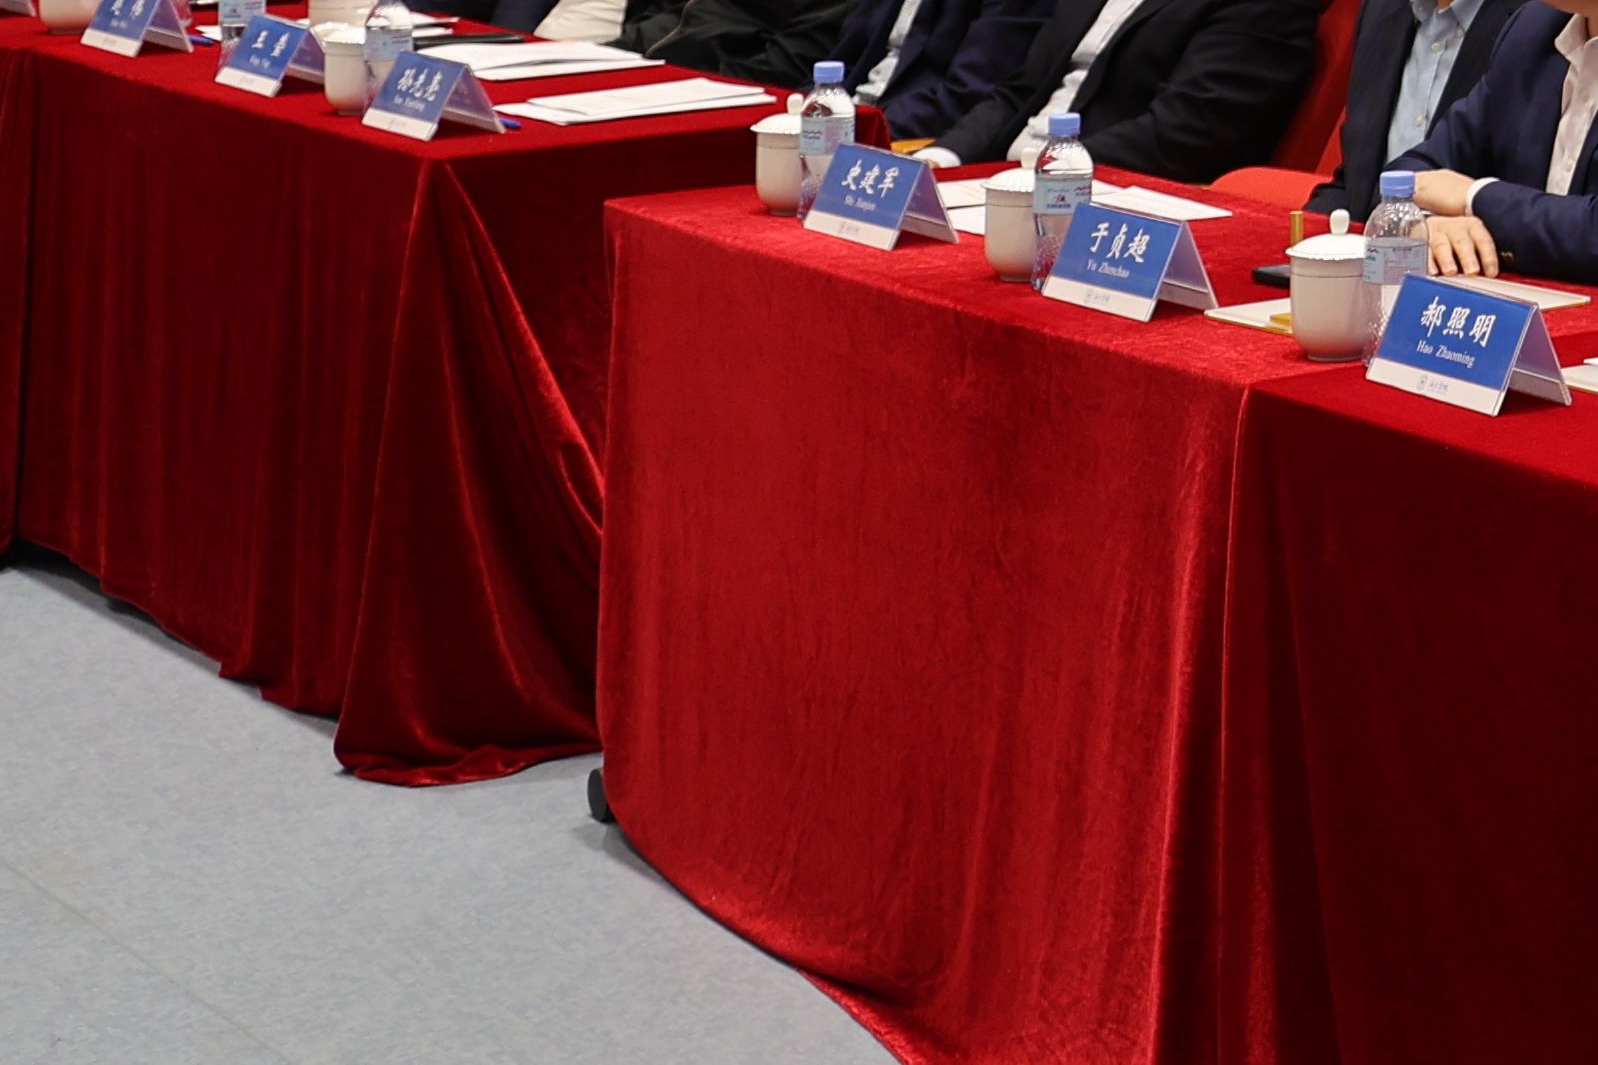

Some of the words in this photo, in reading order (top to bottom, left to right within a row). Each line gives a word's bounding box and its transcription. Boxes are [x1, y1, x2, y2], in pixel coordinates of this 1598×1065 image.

[841, 159, 900, 198] 史建军
[1090, 222, 1150, 263] 于贞超
[1086, 259, 1096, 271] Yu
[1420, 296, 1496, 348] 郝照明
[1416, 339, 1433, 354] Hao
[1435, 345, 1475, 369] Zhaoming
